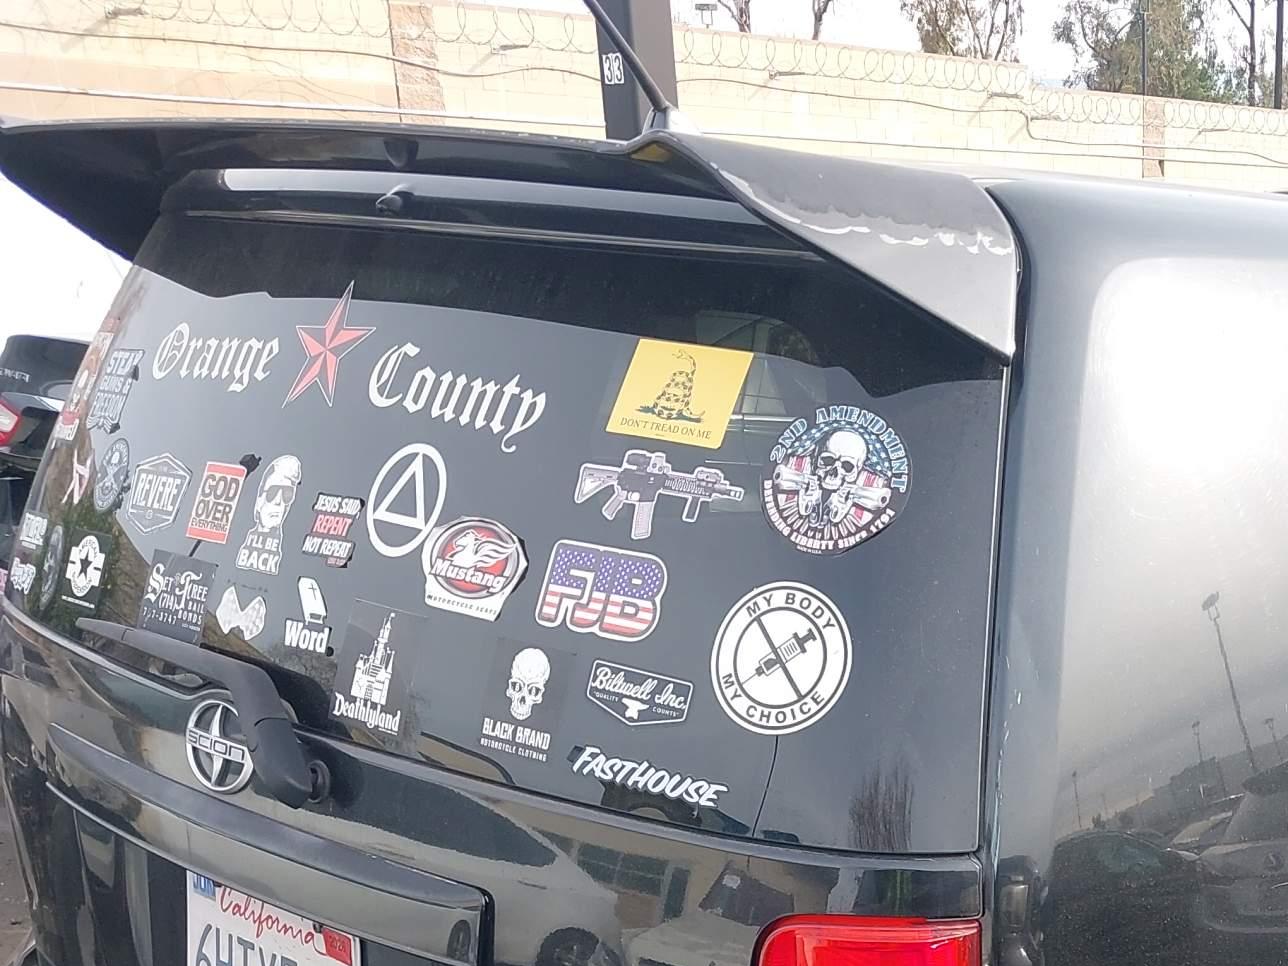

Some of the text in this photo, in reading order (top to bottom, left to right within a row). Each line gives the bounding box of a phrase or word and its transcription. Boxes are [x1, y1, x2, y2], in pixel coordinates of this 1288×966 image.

[604, 54, 623, 83] 33
[151, 322, 547, 453] Orange County
[620, 417, 712, 440] DON'T TREAD ON ME
[770, 405, 908, 493] 2ND AMENDMENT
[133, 472, 182, 512] REVERE
[201, 473, 241, 503] GOD
[314, 494, 342, 513] JESUS
[190, 517, 229, 533] EVERYTHING
[194, 499, 233, 524] OVER
[312, 514, 353, 537] REPENT
[247, 534, 280, 552] I'LL BE
[790, 531, 835, 551] LIBERTY
[870, 508, 896, 534] 1791
[238, 548, 280, 573] BACK
[302, 535, 352, 558] NOT REPEAT
[430, 558, 508, 593] Mustang
[540, 543, 664, 638] FJB
[177, 609, 202, 625] BONDS
[188, 602, 205, 614] BAIL
[427, 594, 473, 610] MOTORCYCLE
[745, 592, 836, 631] MY BODY
[591, 666, 658, 701] Biltwell
[721, 673, 826, 725] MY CHOICE
[332, 691, 401, 732] Deathlyland
[482, 717, 551, 751] BLACK BRAND
[572, 746, 728, 808] FASTHOUSE
[219, 886, 327, 956] California
